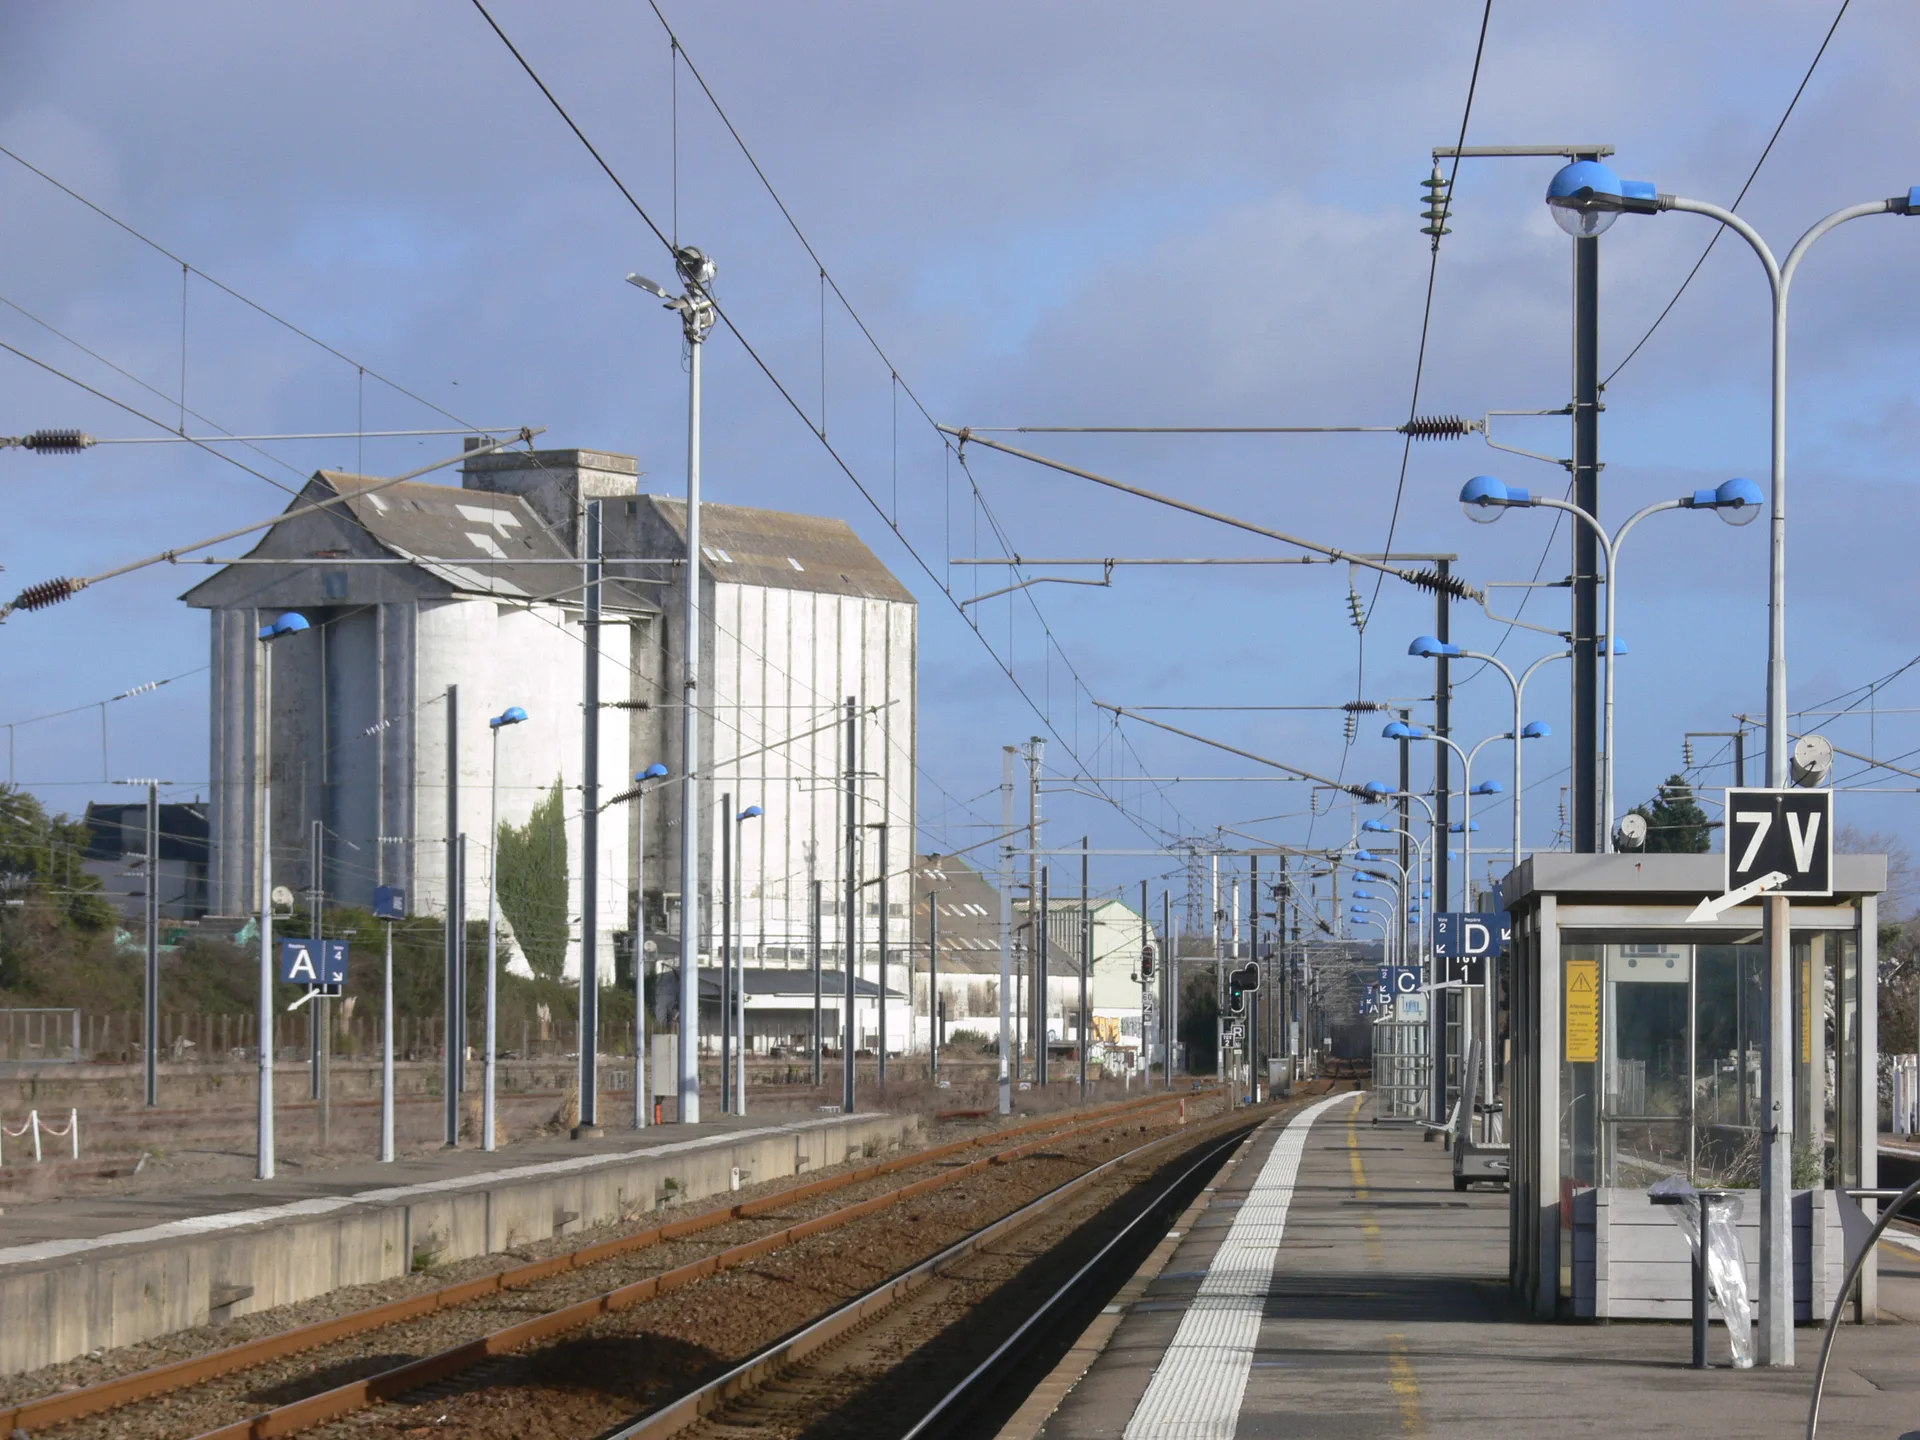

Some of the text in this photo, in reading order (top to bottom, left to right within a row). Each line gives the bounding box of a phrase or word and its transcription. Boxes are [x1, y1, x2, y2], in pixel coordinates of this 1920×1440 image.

[1439, 922, 1446, 933] 2
[1465, 923, 1490, 954] D
[334, 951, 342, 960] 4
[288, 949, 317, 979] A
[1382, 971, 1388, 979] 2
[1398, 972, 1415, 993] C
[1233, 1027, 1242, 1037] R
